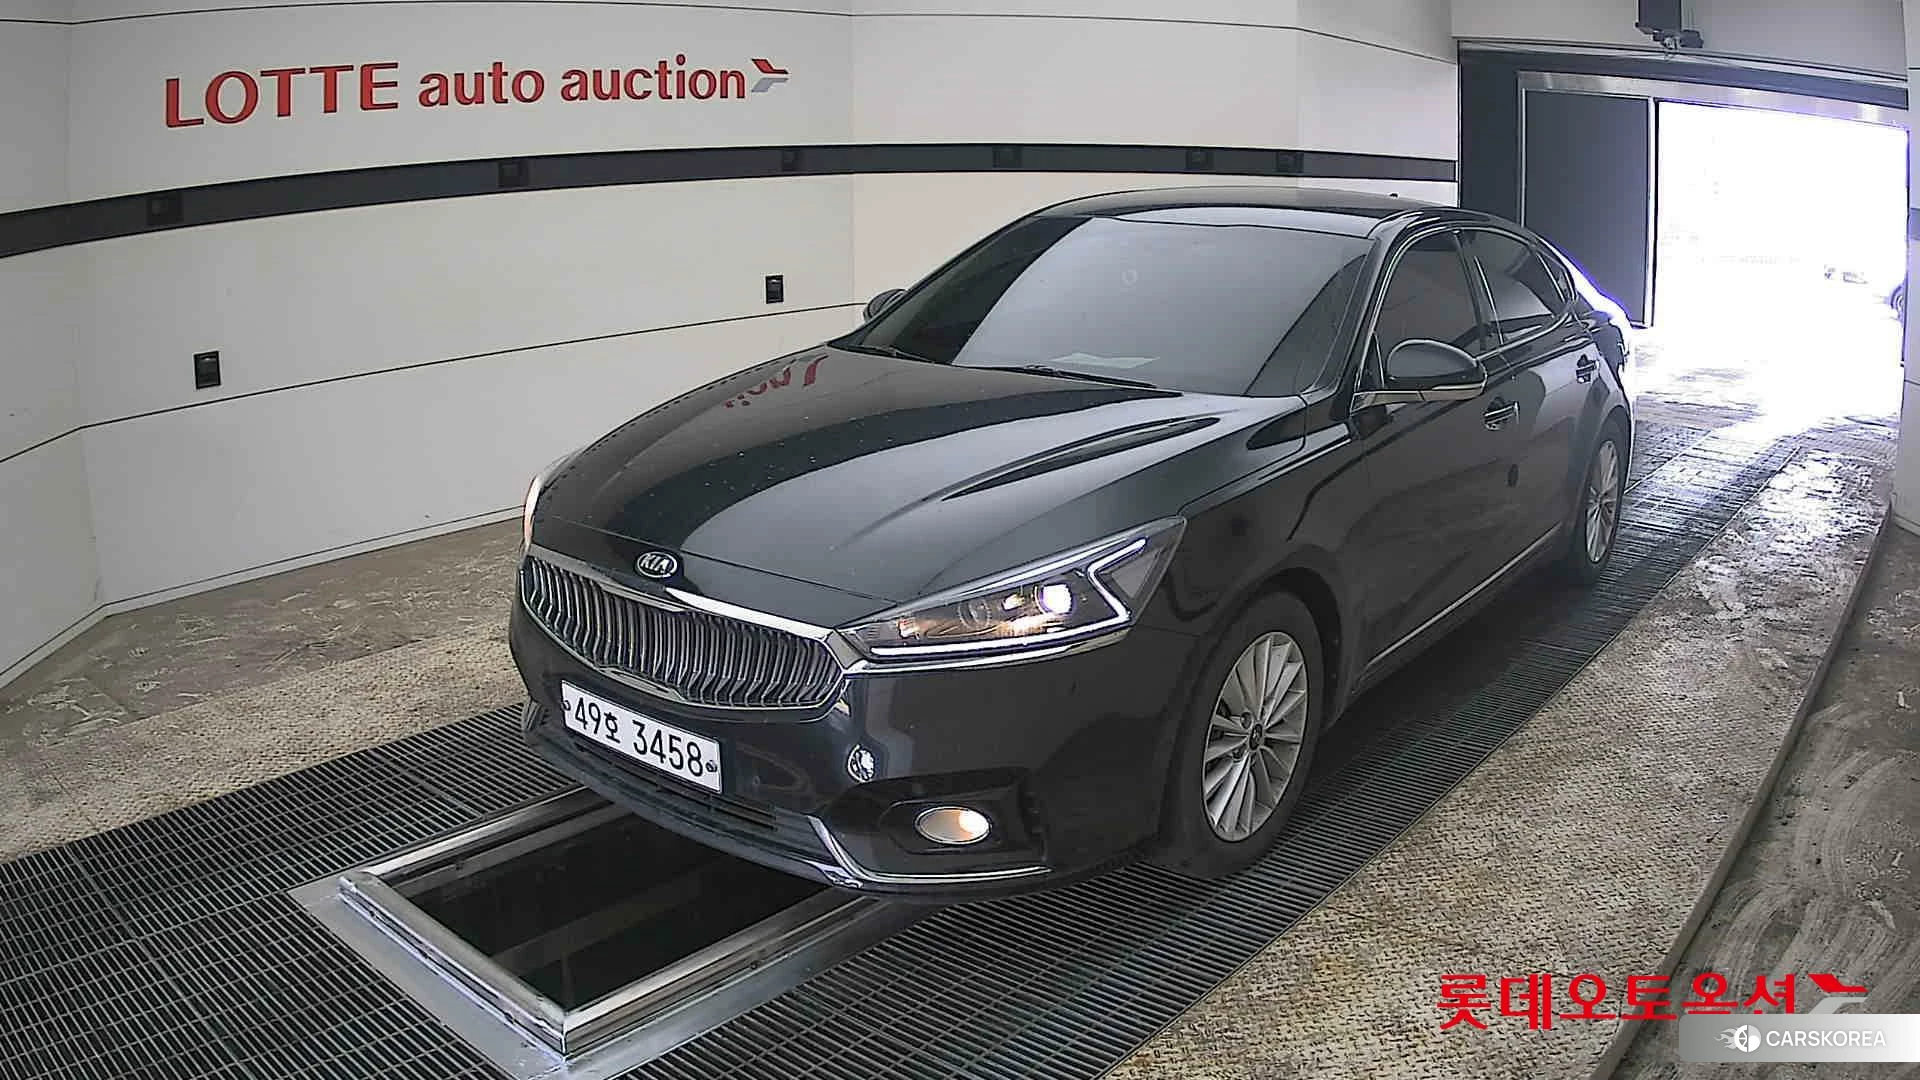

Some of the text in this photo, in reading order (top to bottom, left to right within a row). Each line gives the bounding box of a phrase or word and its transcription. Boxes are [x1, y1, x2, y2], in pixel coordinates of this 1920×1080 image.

[165, 53, 746, 128] LOTTE auto auction
[639, 553, 673, 574] KIA
[574, 697, 703, 777] 49호 3458
